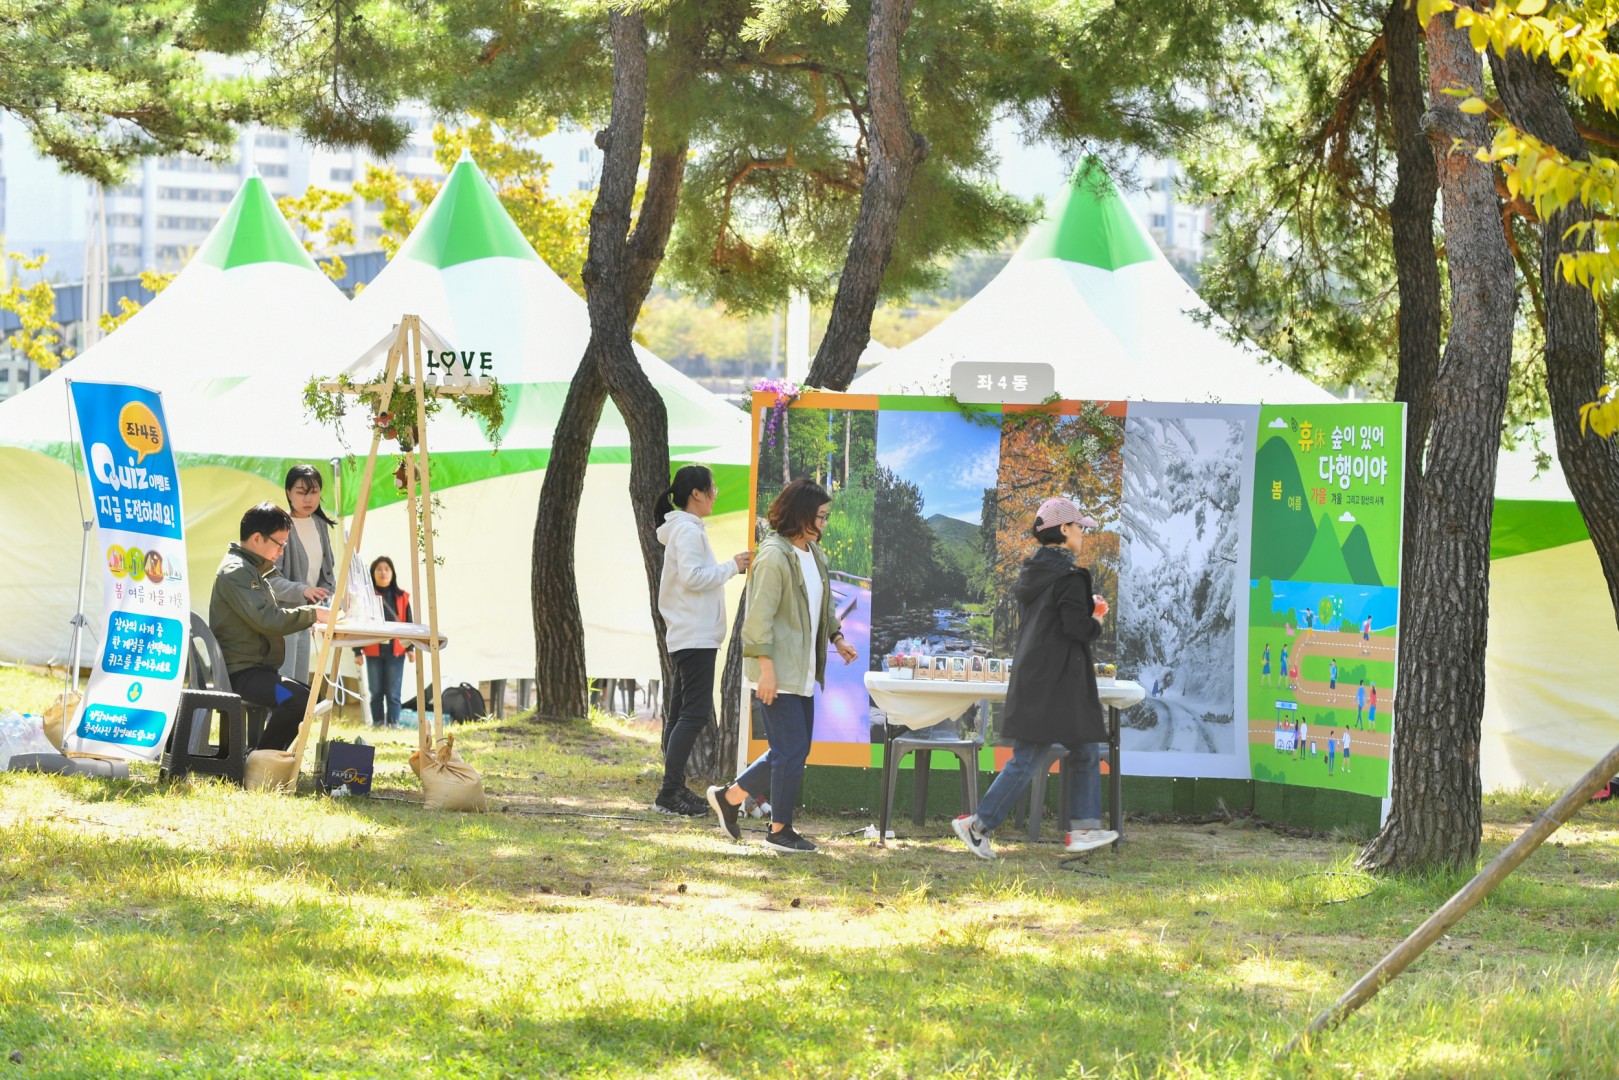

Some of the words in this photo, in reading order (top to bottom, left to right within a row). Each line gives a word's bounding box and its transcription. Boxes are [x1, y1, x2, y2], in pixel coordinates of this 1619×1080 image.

[427, 350, 492, 370] LOVE
[126, 422, 159, 444] 좌4동
[1331, 425, 1355, 450] 숲이
[1360, 425, 1384, 450] 있어
[1319, 453, 1388, 490] 다행이야
[149, 473, 171, 492] 이벤트
[1271, 480, 1283, 500] 봄
[1287, 495, 1302, 511] 여름
[1311, 487, 1327, 505] 가을
[1331, 492, 1342, 505] 겨울
[1346, 495, 1360, 505] 그리고
[1361, 495, 1374, 506] 장산의
[1374, 495, 1384, 506] 사계
[98, 495, 122, 524] 지금
[124, 498, 175, 528] 도전하세요!
[115, 582, 123, 599] 봄
[128, 586, 145, 603] 여름
[149, 589, 165, 606] 가을
[169, 592, 183, 608] 겨울
[114, 617, 137, 633] 장산의
[139, 622, 155, 635] 사계
[156, 622, 164, 637] 중
[112, 635, 121, 649] 한
[122, 638, 145, 653] 계절을
[108, 653, 131, 670] 퀴즈를
[134, 655, 171, 672] 풀어주세요
